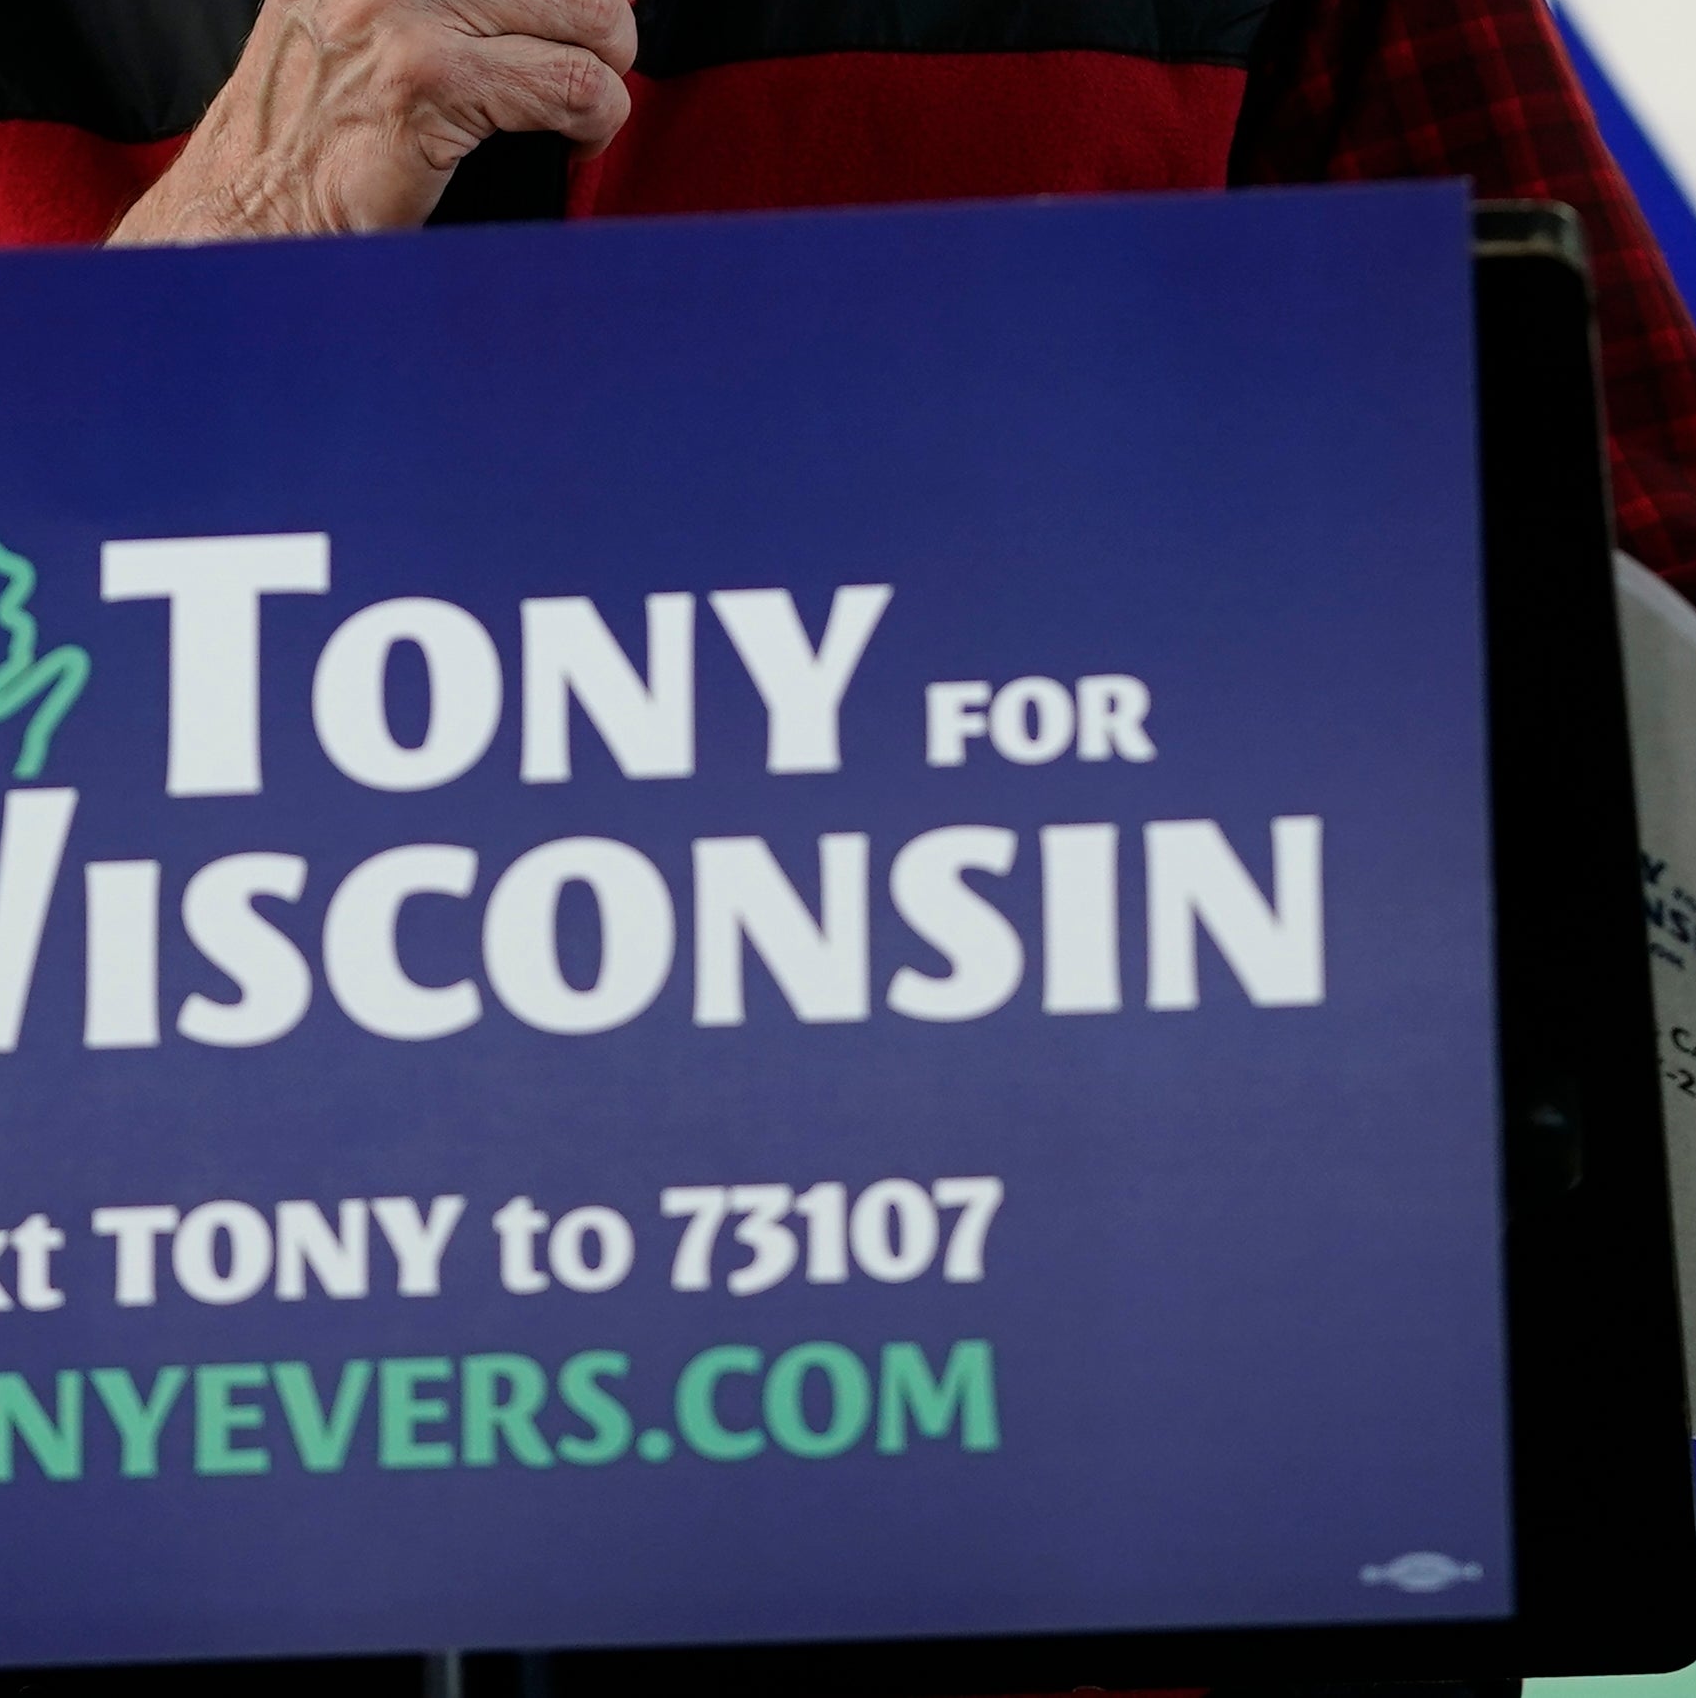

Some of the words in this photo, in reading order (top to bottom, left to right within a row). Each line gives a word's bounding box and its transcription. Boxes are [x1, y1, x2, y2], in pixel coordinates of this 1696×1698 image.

[100, 531, 891, 797] TONY
[926, 674, 1155, 767] FOR
[91, 1194, 465, 1306] TONY
[493, 1196, 634, 1293] to
[661, 1176, 1003, 1294] 73107
